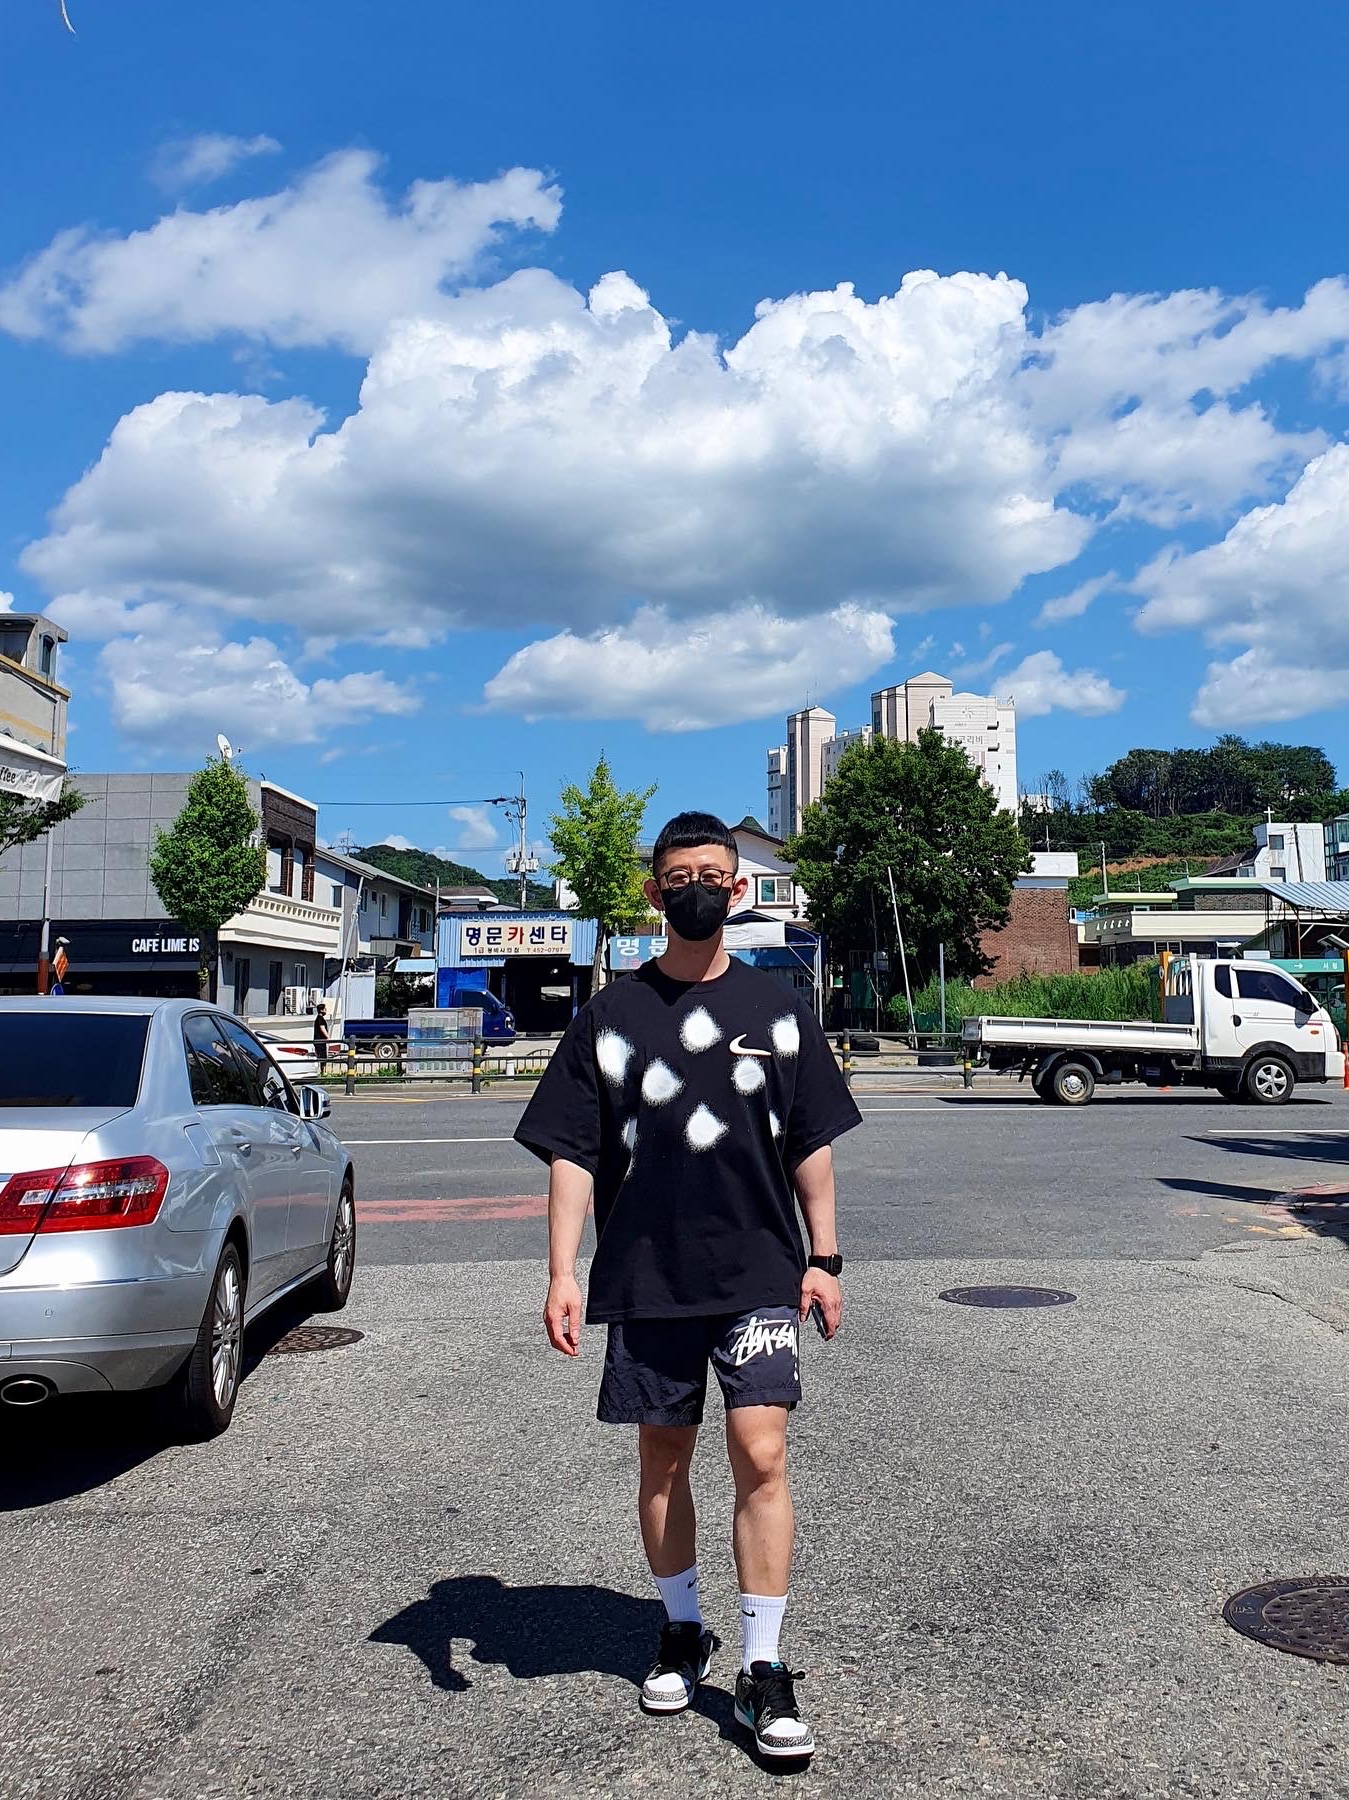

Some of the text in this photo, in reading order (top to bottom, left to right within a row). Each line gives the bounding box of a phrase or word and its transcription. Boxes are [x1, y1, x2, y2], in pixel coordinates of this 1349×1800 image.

[466, 926, 568, 946] 명문카센타
[132, 938, 200, 952] CAFE LIME IS
